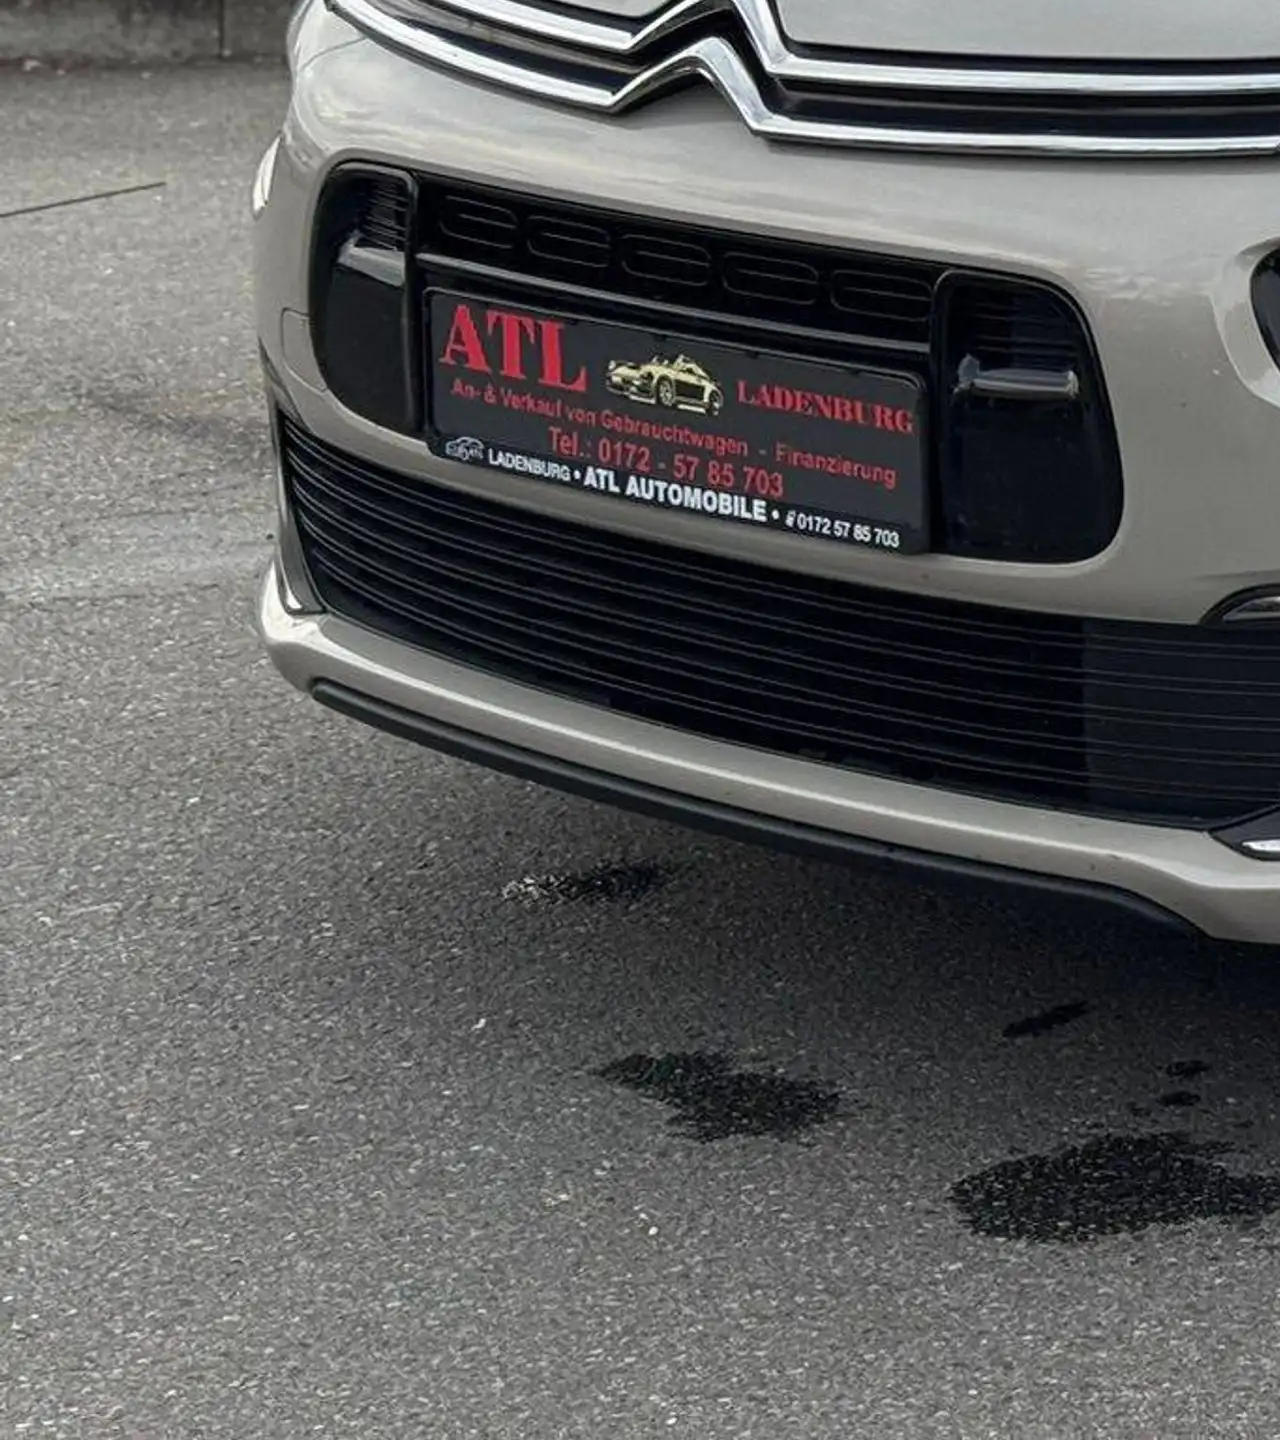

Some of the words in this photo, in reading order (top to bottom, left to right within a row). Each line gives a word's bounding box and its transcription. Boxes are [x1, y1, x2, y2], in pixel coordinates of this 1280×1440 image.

[437, 304, 588, 392] ATL
[735, 379, 914, 435] LADENBURG
[451, 378, 482, 398] An-
[484, 386, 497, 404] &
[500, 389, 562, 418] Verkauf
[565, 405, 596, 426] von
[599, 409, 749, 457] Gebrauchtwagen
[775, 441, 897, 490] Finanzierung
[548, 426, 592, 459] Tel.:
[598, 438, 651, 473] 0172
[673, 454, 701, 481] 57
[706, 461, 735, 488] 85
[742, 465, 784, 499] 703
[487, 448, 572, 482] LADENBURG
[583, 466, 620, 494] ATL
[625, 476, 768, 523] AUTOMOBILE
[796, 512, 831, 536] 0172
[832, 519, 852, 539] 57
[853, 524, 872, 544] 85
[874, 527, 900, 549] 703
